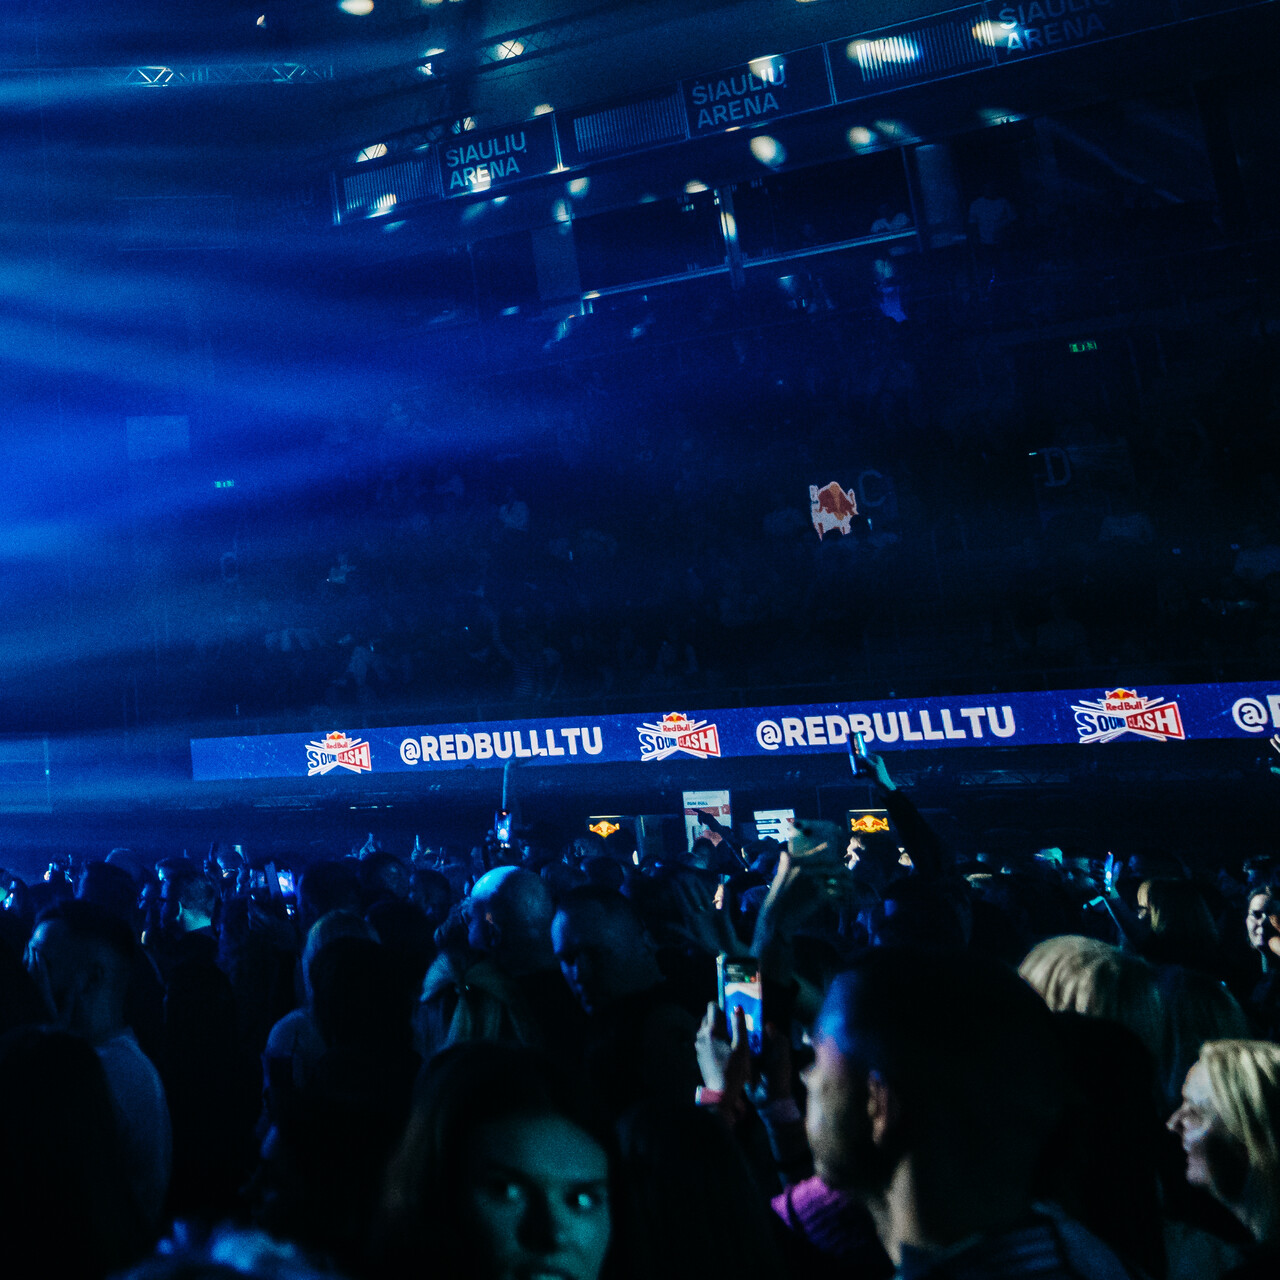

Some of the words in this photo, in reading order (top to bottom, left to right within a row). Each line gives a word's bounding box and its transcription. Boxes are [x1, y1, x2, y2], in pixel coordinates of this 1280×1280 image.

[1006, 12, 1106, 55] ARENA
[697, 92, 779, 128] ARENA
[449, 156, 520, 189] ARENA
[1105, 702, 1124, 711] Red
[1125, 701, 1142, 710] Bull
[399, 726, 603, 766] @REDBULLLTU
[662, 724, 676, 732] Red
[755, 705, 1016, 751] @REDBULLLTU
